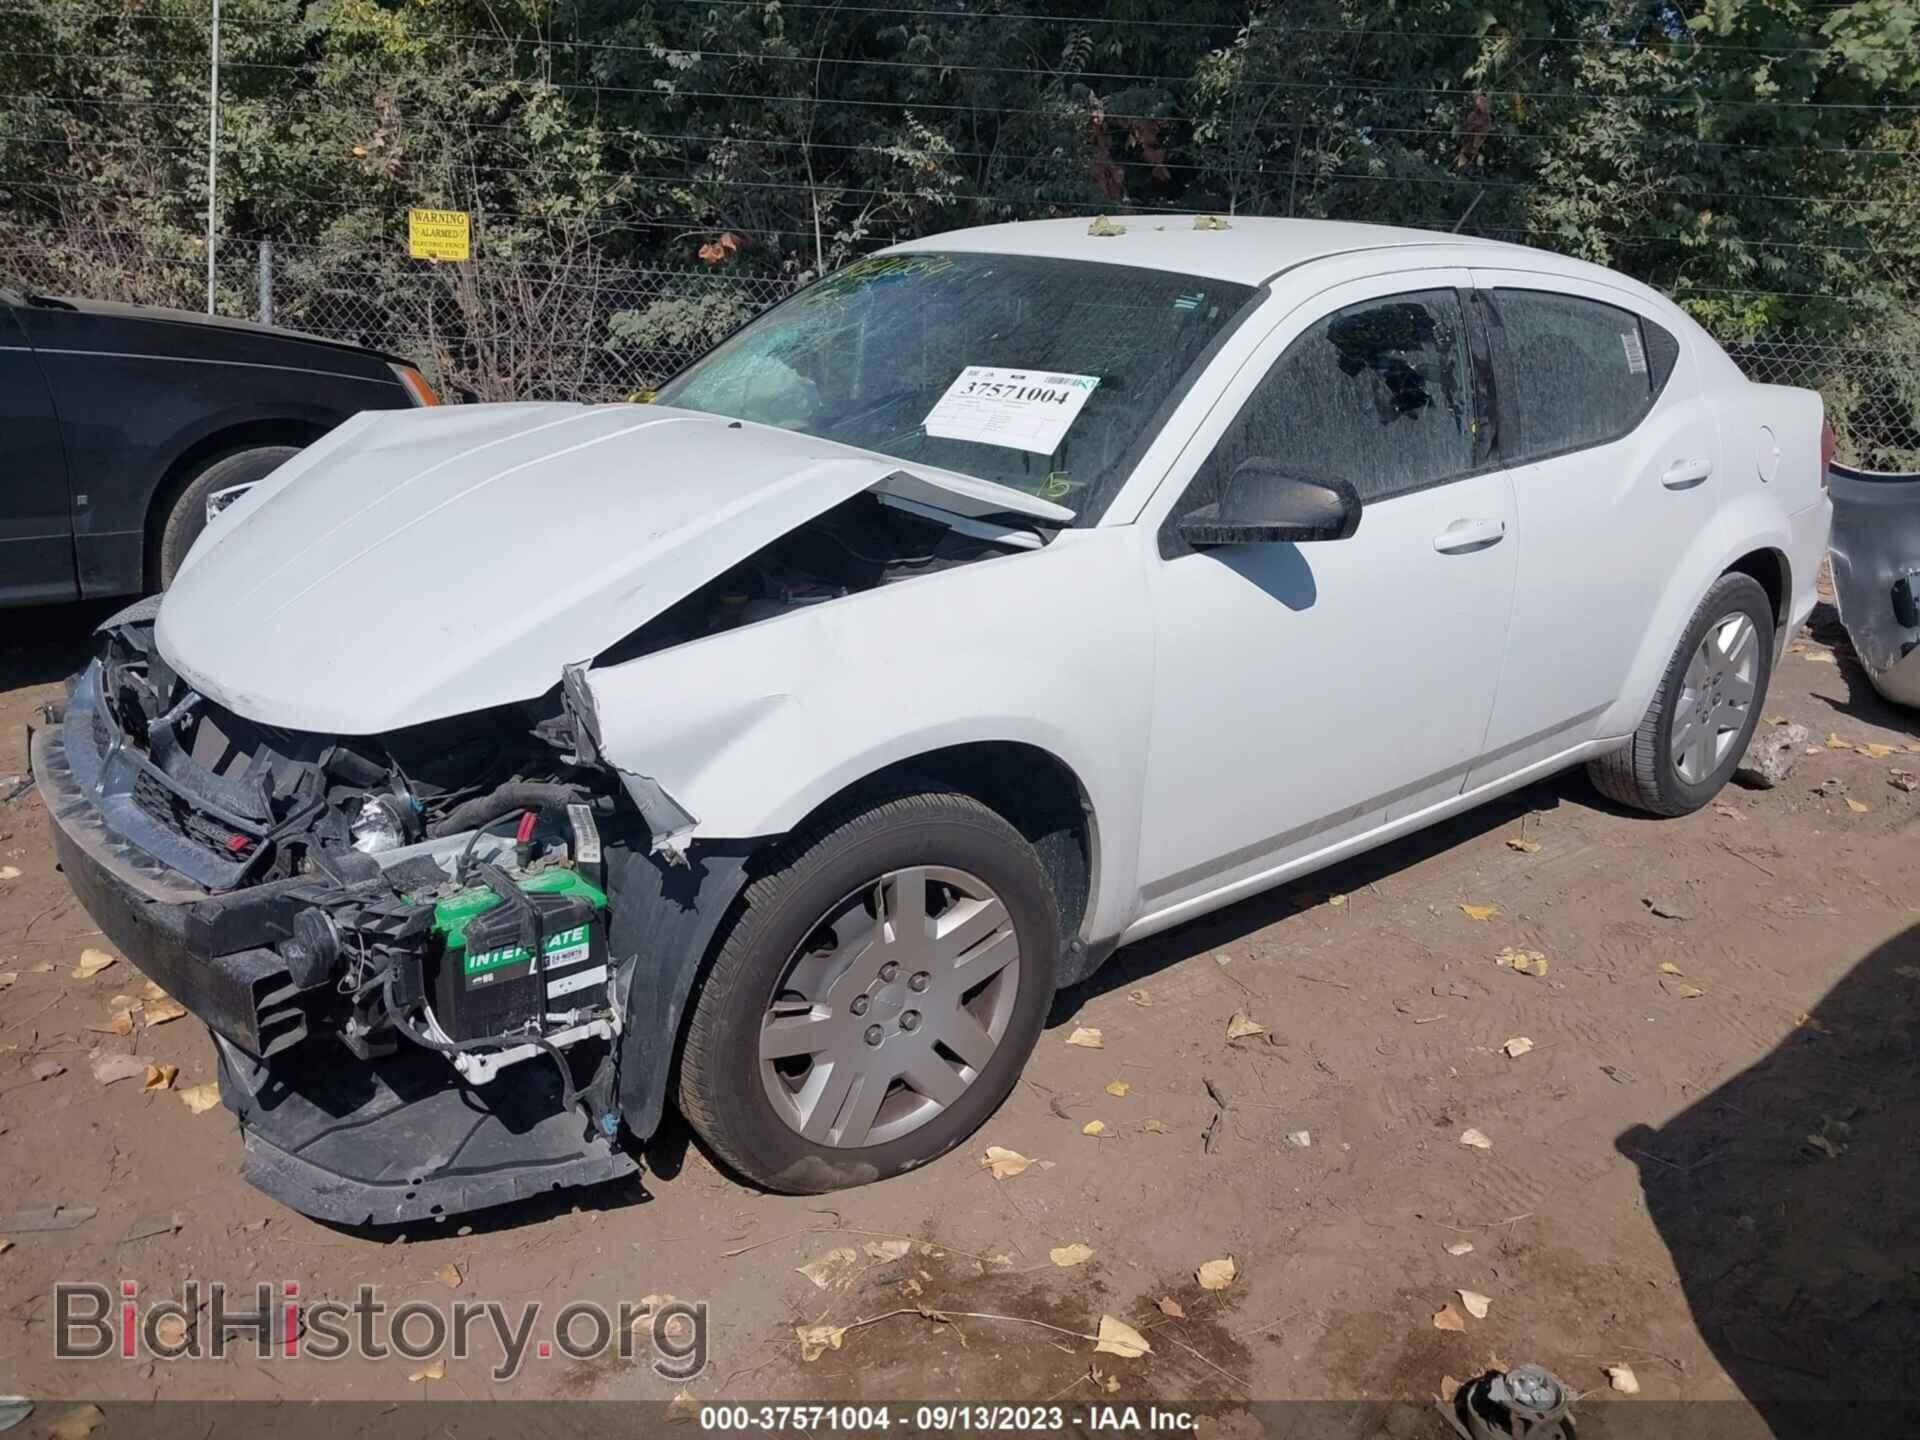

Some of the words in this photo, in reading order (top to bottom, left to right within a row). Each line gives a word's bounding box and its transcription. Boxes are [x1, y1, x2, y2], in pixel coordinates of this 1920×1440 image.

[415, 211, 464, 225] WARNING
[421, 228, 458, 238] ALARMED
[960, 381, 1070, 405] 37571004
